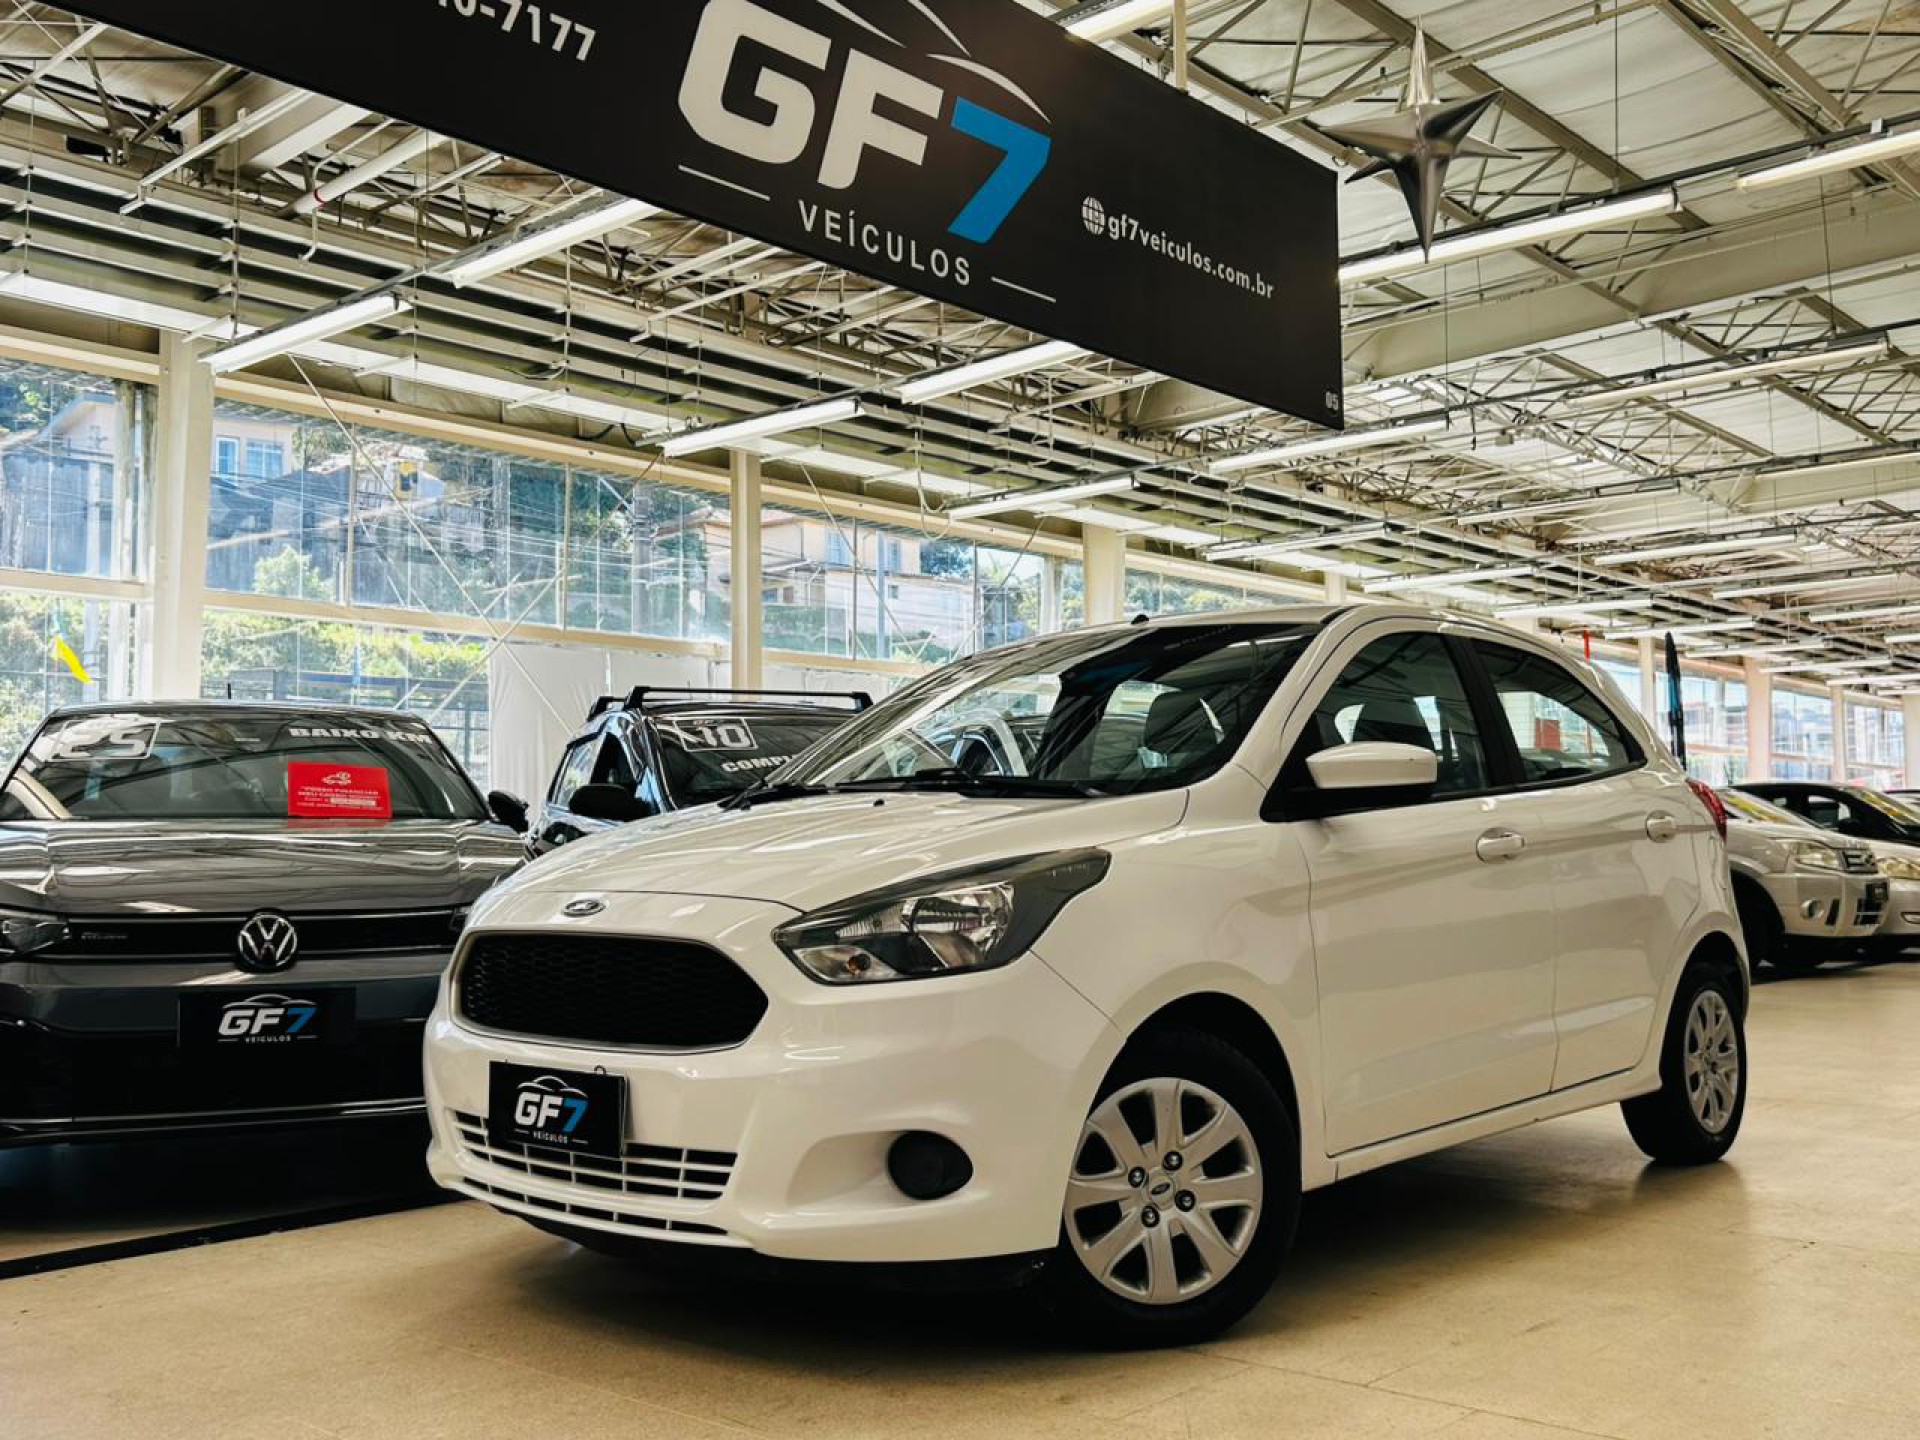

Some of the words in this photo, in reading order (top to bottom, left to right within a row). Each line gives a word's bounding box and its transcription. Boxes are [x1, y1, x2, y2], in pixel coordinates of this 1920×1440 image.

[438, 0, 596, 61] -7177
[678, 0, 1051, 244] GF7
[798, 199, 971, 286] VEÍCULOS
[1107, 213, 1275, 299] gf7veiculos.com.br
[289, 728, 380, 739] BAIXO
[696, 724, 751, 748] 10
[720, 755, 799, 772] COMPL
[218, 1007, 317, 1036] GF7
[515, 1091, 589, 1133] GF7
